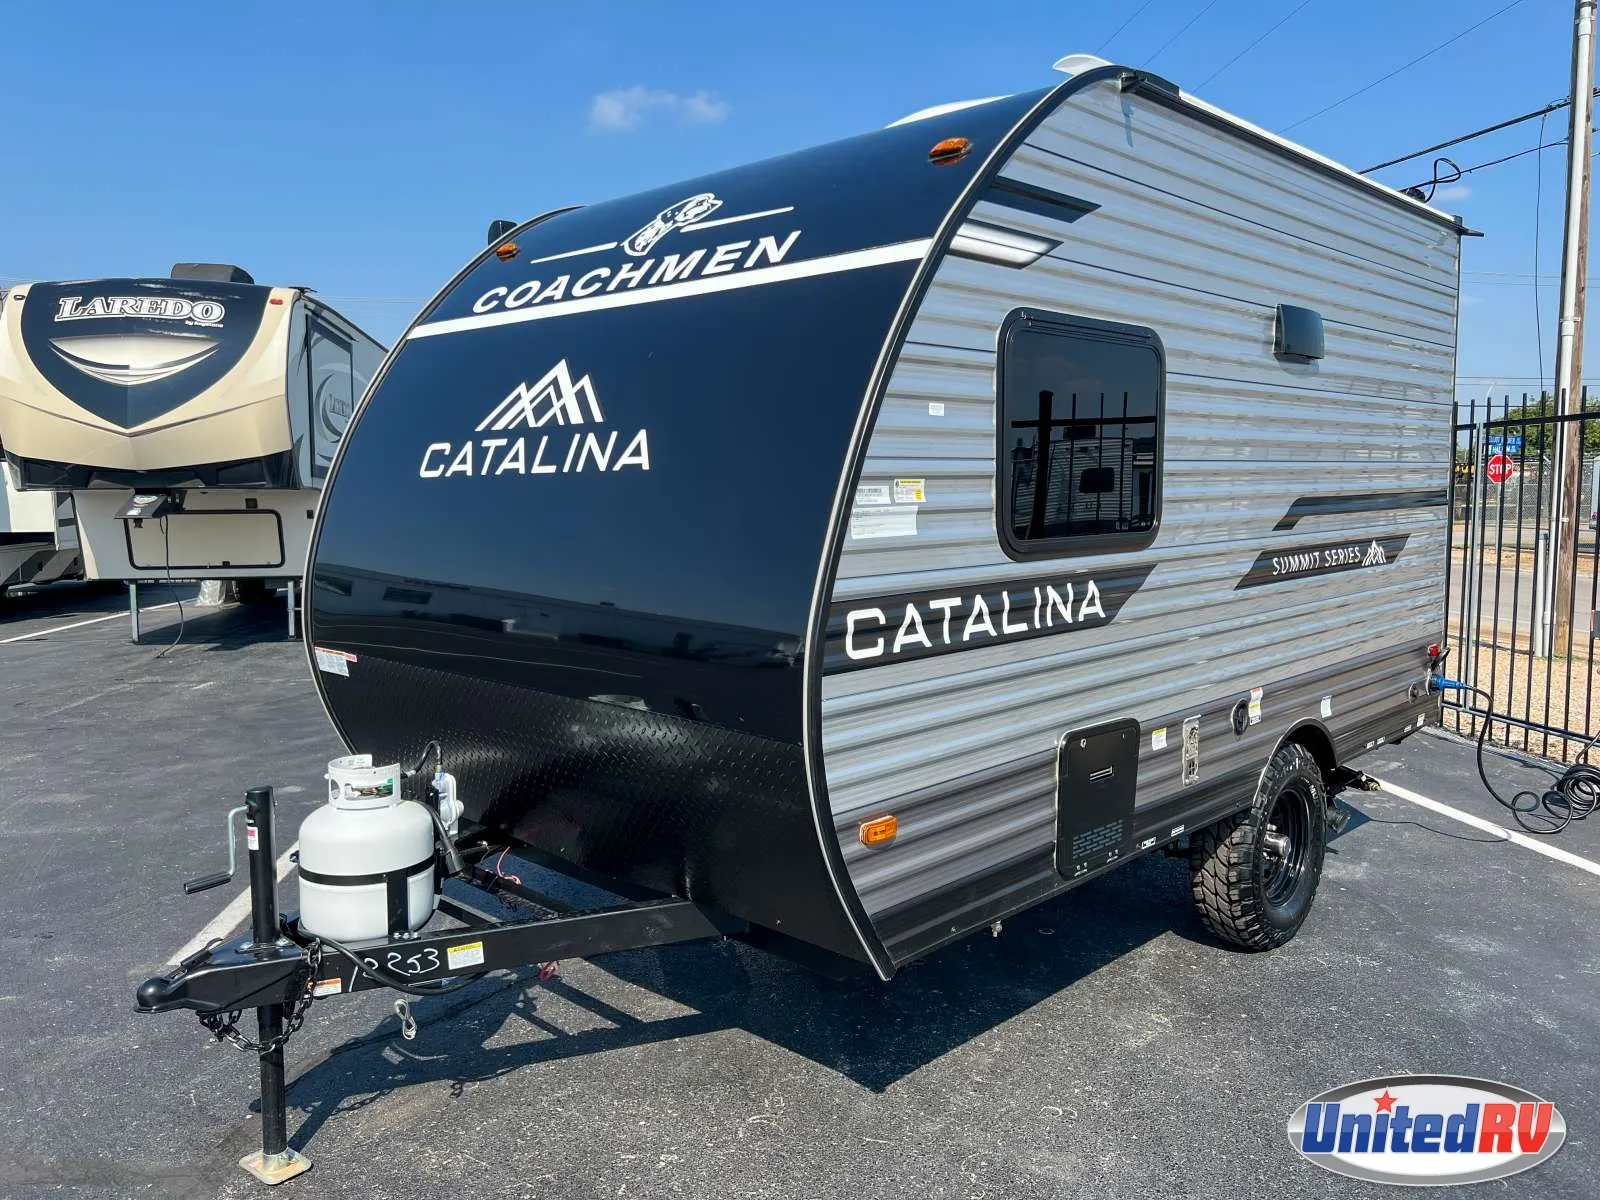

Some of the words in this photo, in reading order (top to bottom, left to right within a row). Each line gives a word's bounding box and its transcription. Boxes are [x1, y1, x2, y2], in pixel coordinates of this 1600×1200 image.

[472, 230, 801, 313] COACHMEN
[55, 296, 226, 323] LAREDO
[419, 429, 650, 479] CATALINA
[1272, 552, 1320, 575] SUMMIT
[1324, 547, 1361, 567] SERIES
[845, 580, 1107, 660] CATALINA
